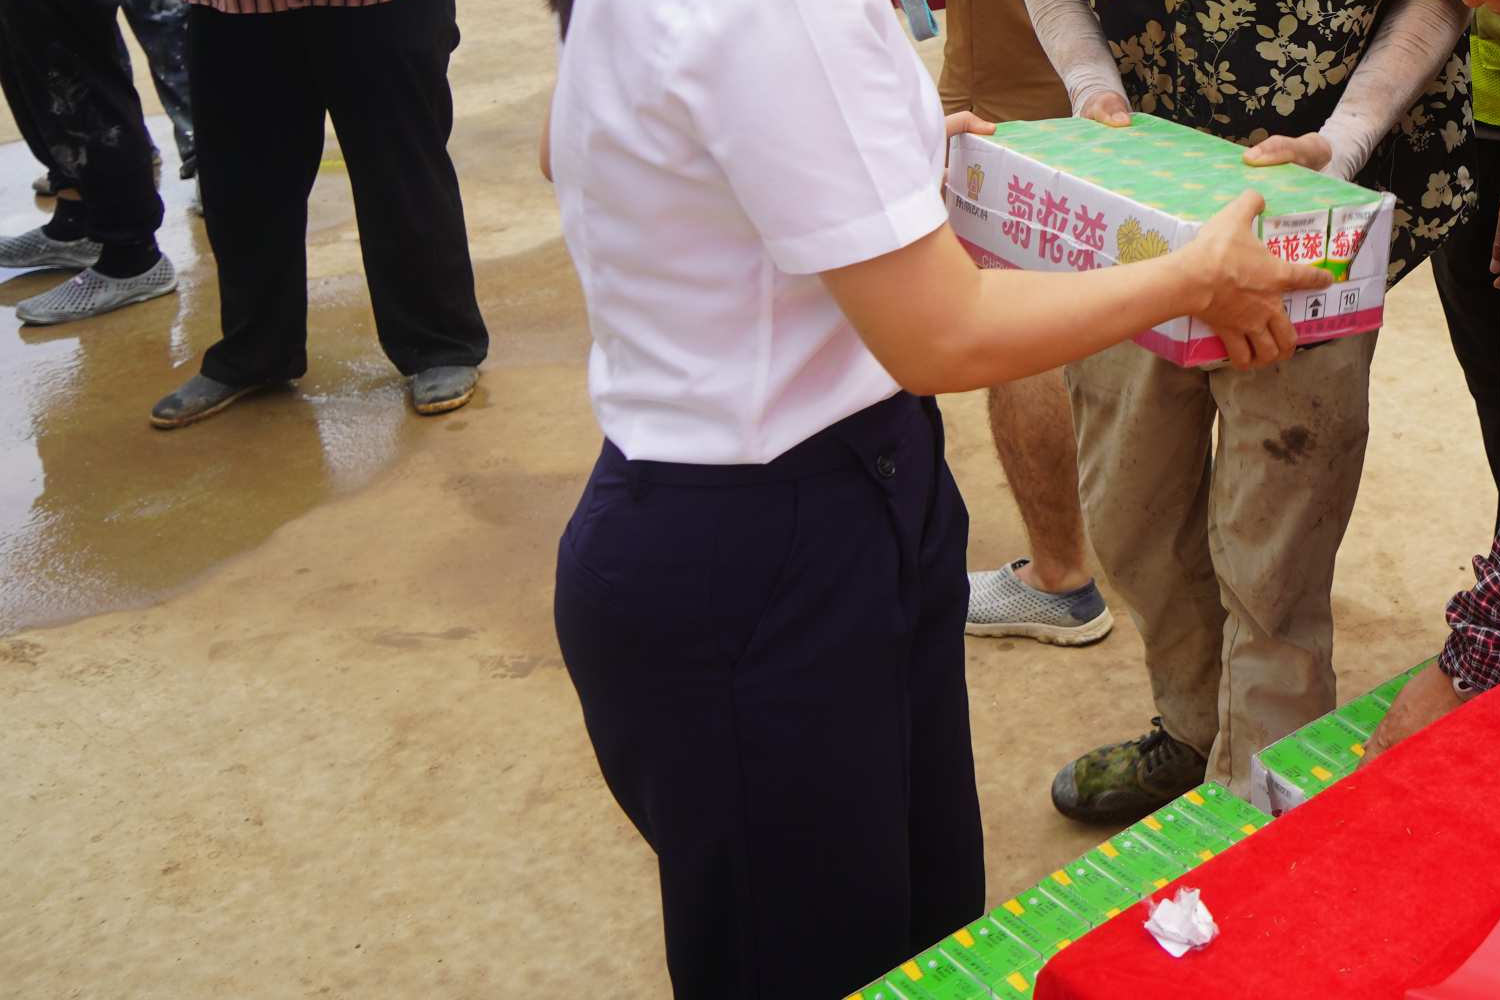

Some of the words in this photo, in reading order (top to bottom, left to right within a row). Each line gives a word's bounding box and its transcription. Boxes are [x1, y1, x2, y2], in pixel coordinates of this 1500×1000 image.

[1002, 174, 1108, 272] 菊花茶
[1344, 292, 1356, 306] 10
